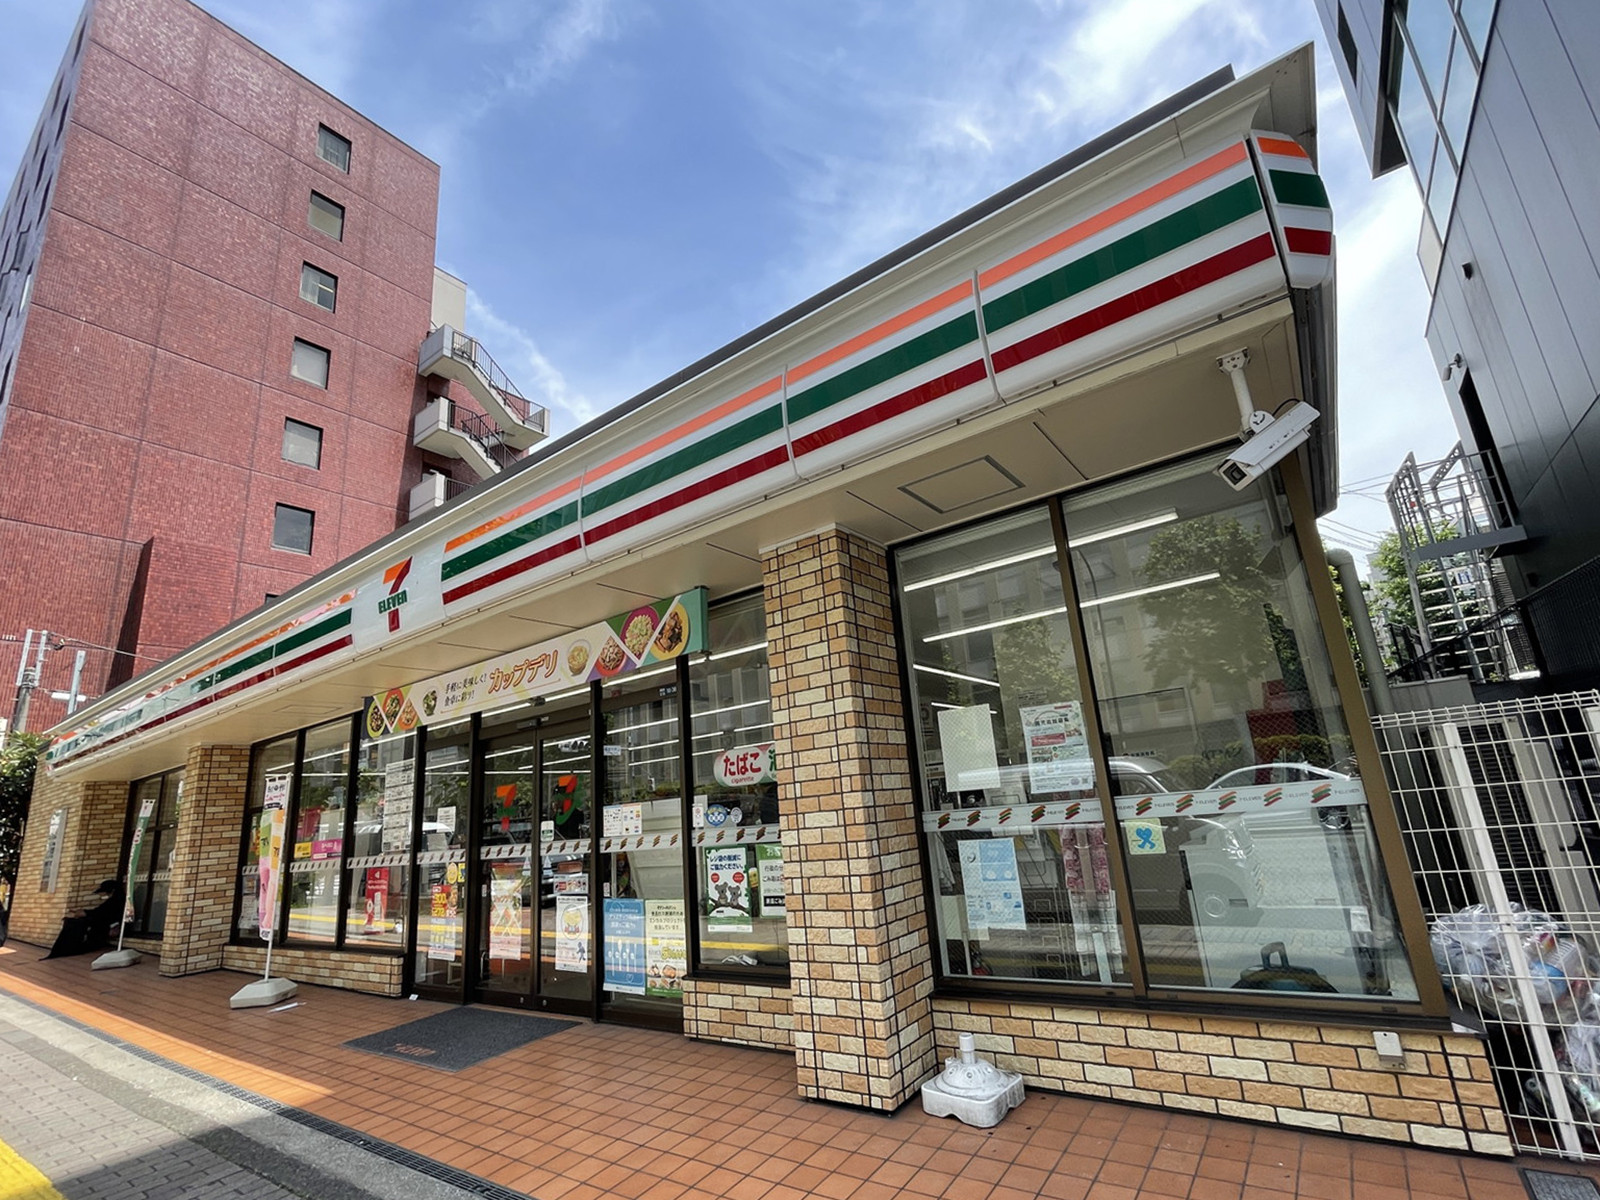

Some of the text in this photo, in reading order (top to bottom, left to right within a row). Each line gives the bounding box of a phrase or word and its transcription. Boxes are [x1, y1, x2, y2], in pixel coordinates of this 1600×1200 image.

[488, 649, 558, 694] カップデリ
[723, 752, 762, 777] たばこ
